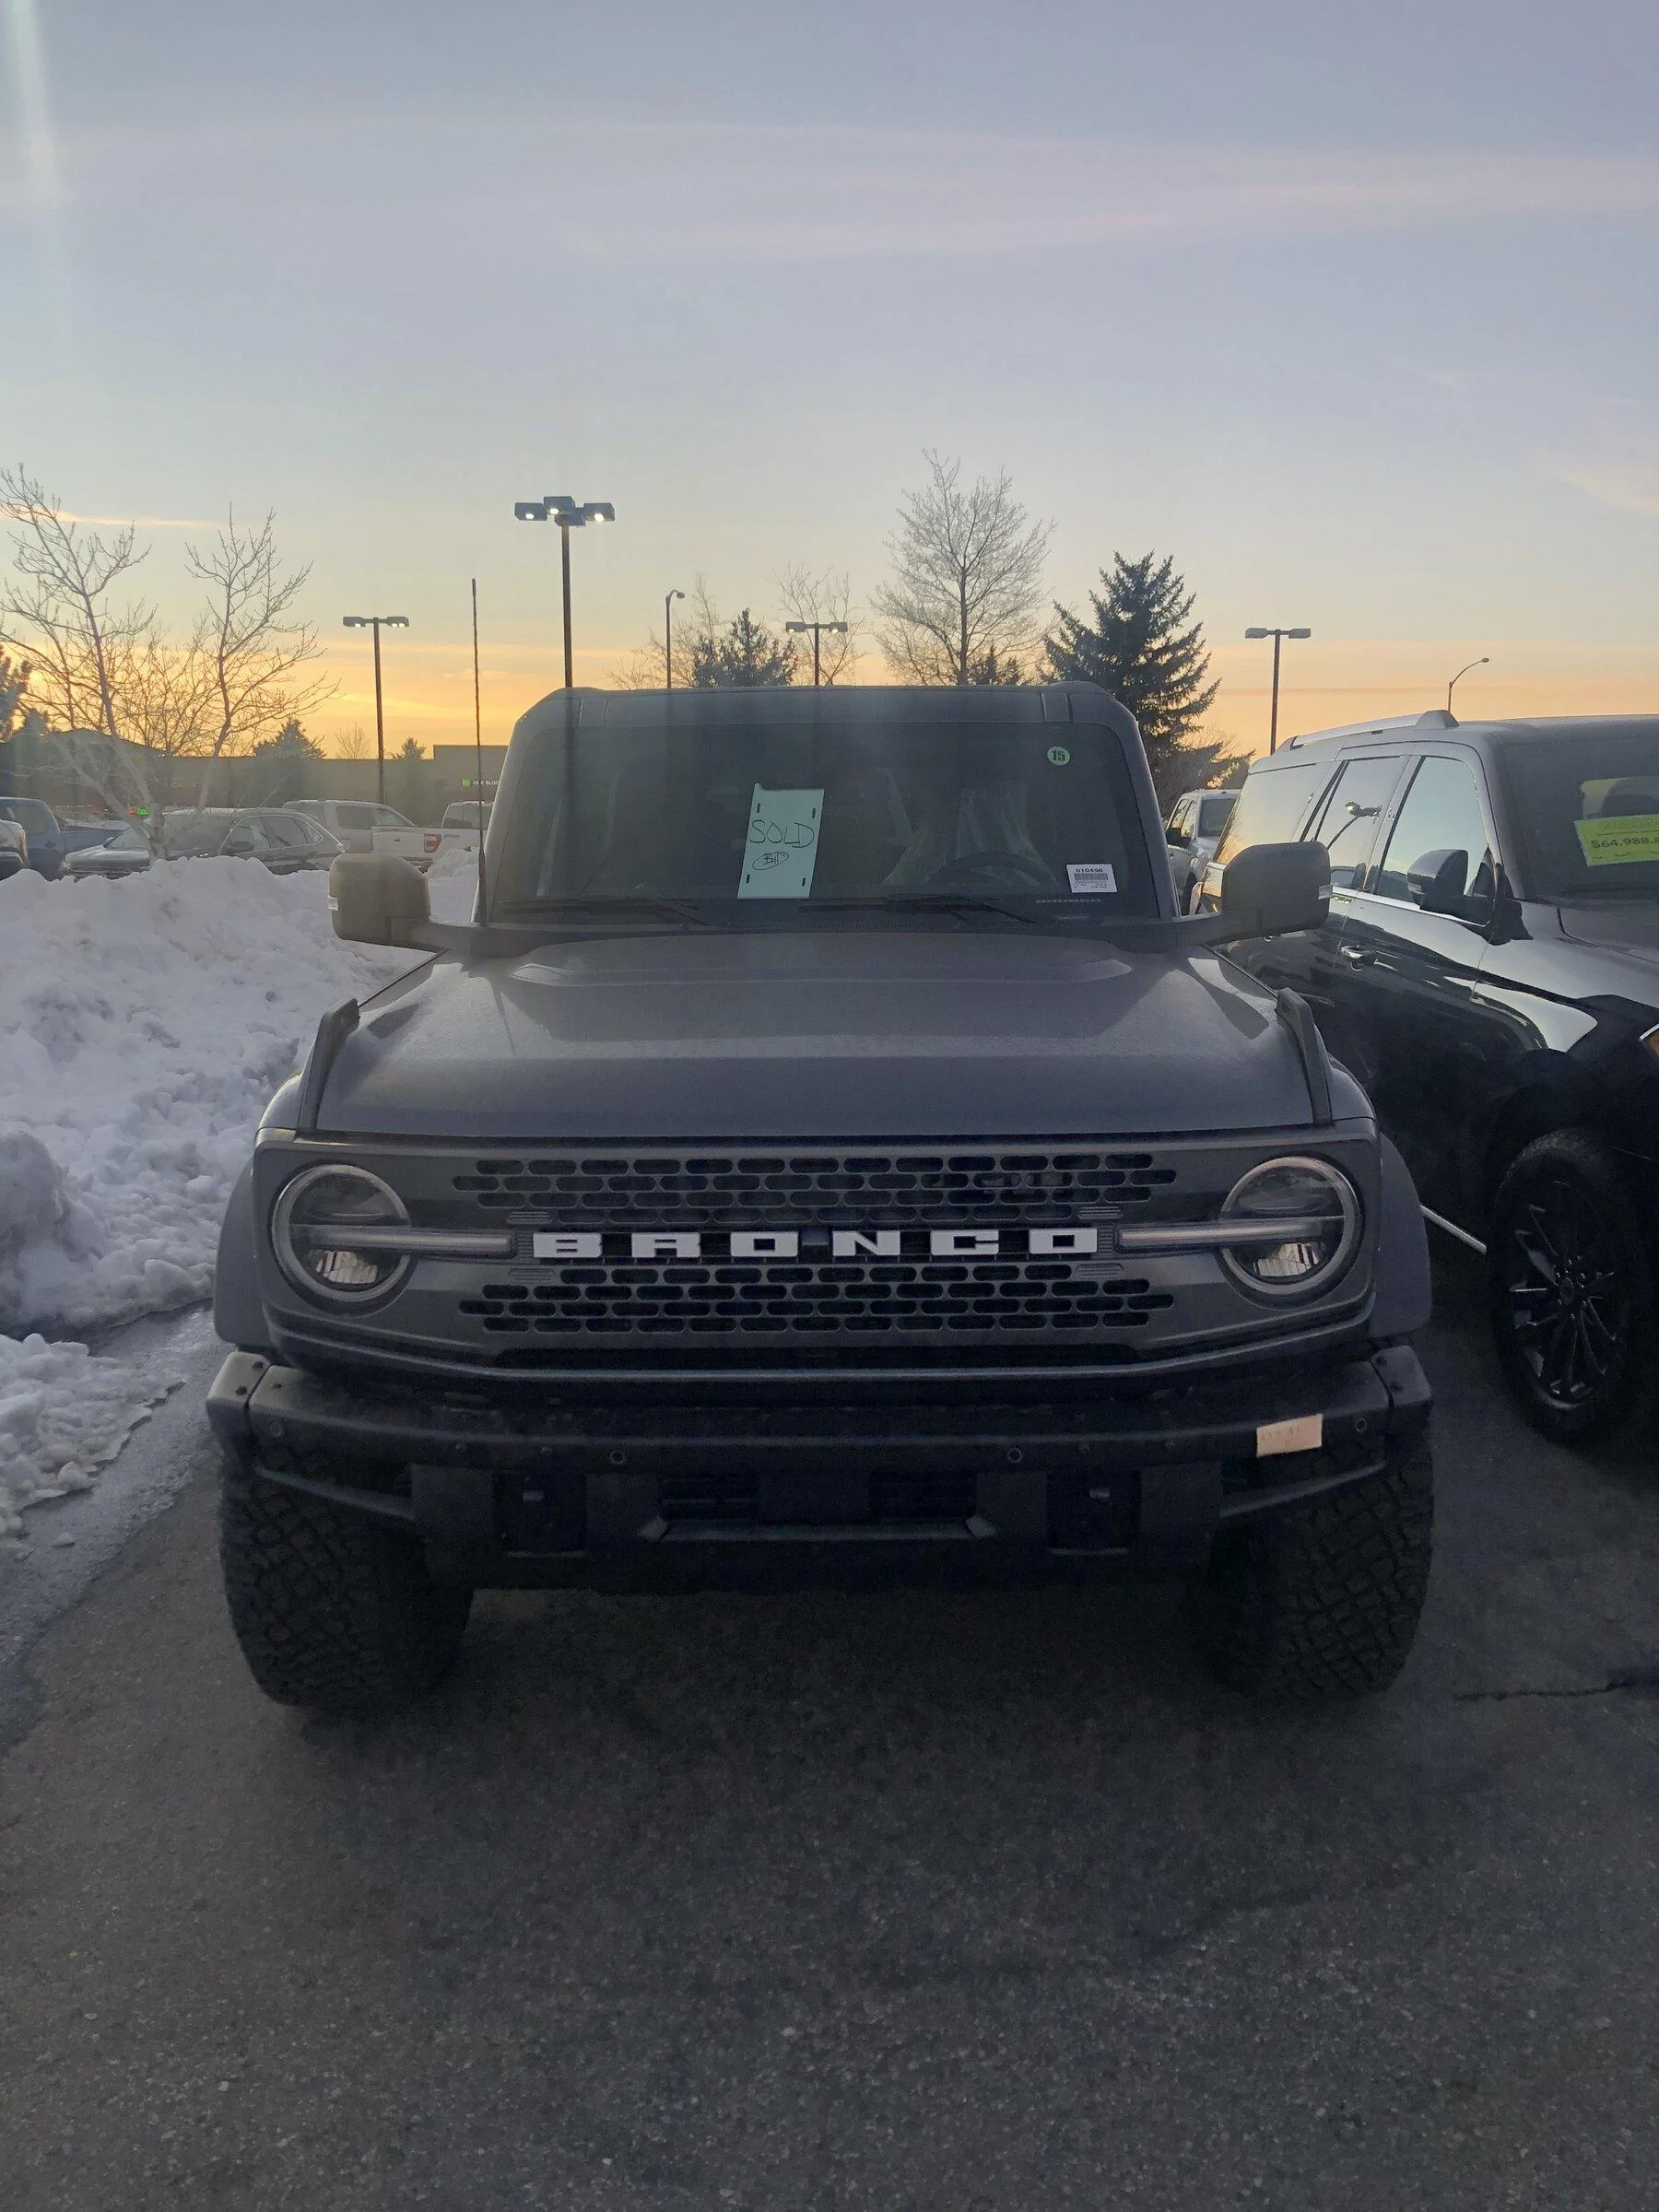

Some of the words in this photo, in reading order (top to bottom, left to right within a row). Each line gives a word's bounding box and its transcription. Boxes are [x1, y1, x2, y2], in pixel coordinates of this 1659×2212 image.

[1053, 749, 1066, 763] 15
[749, 819, 815, 848] SOLD
[533, 1228, 1098, 1258] BRONCO
